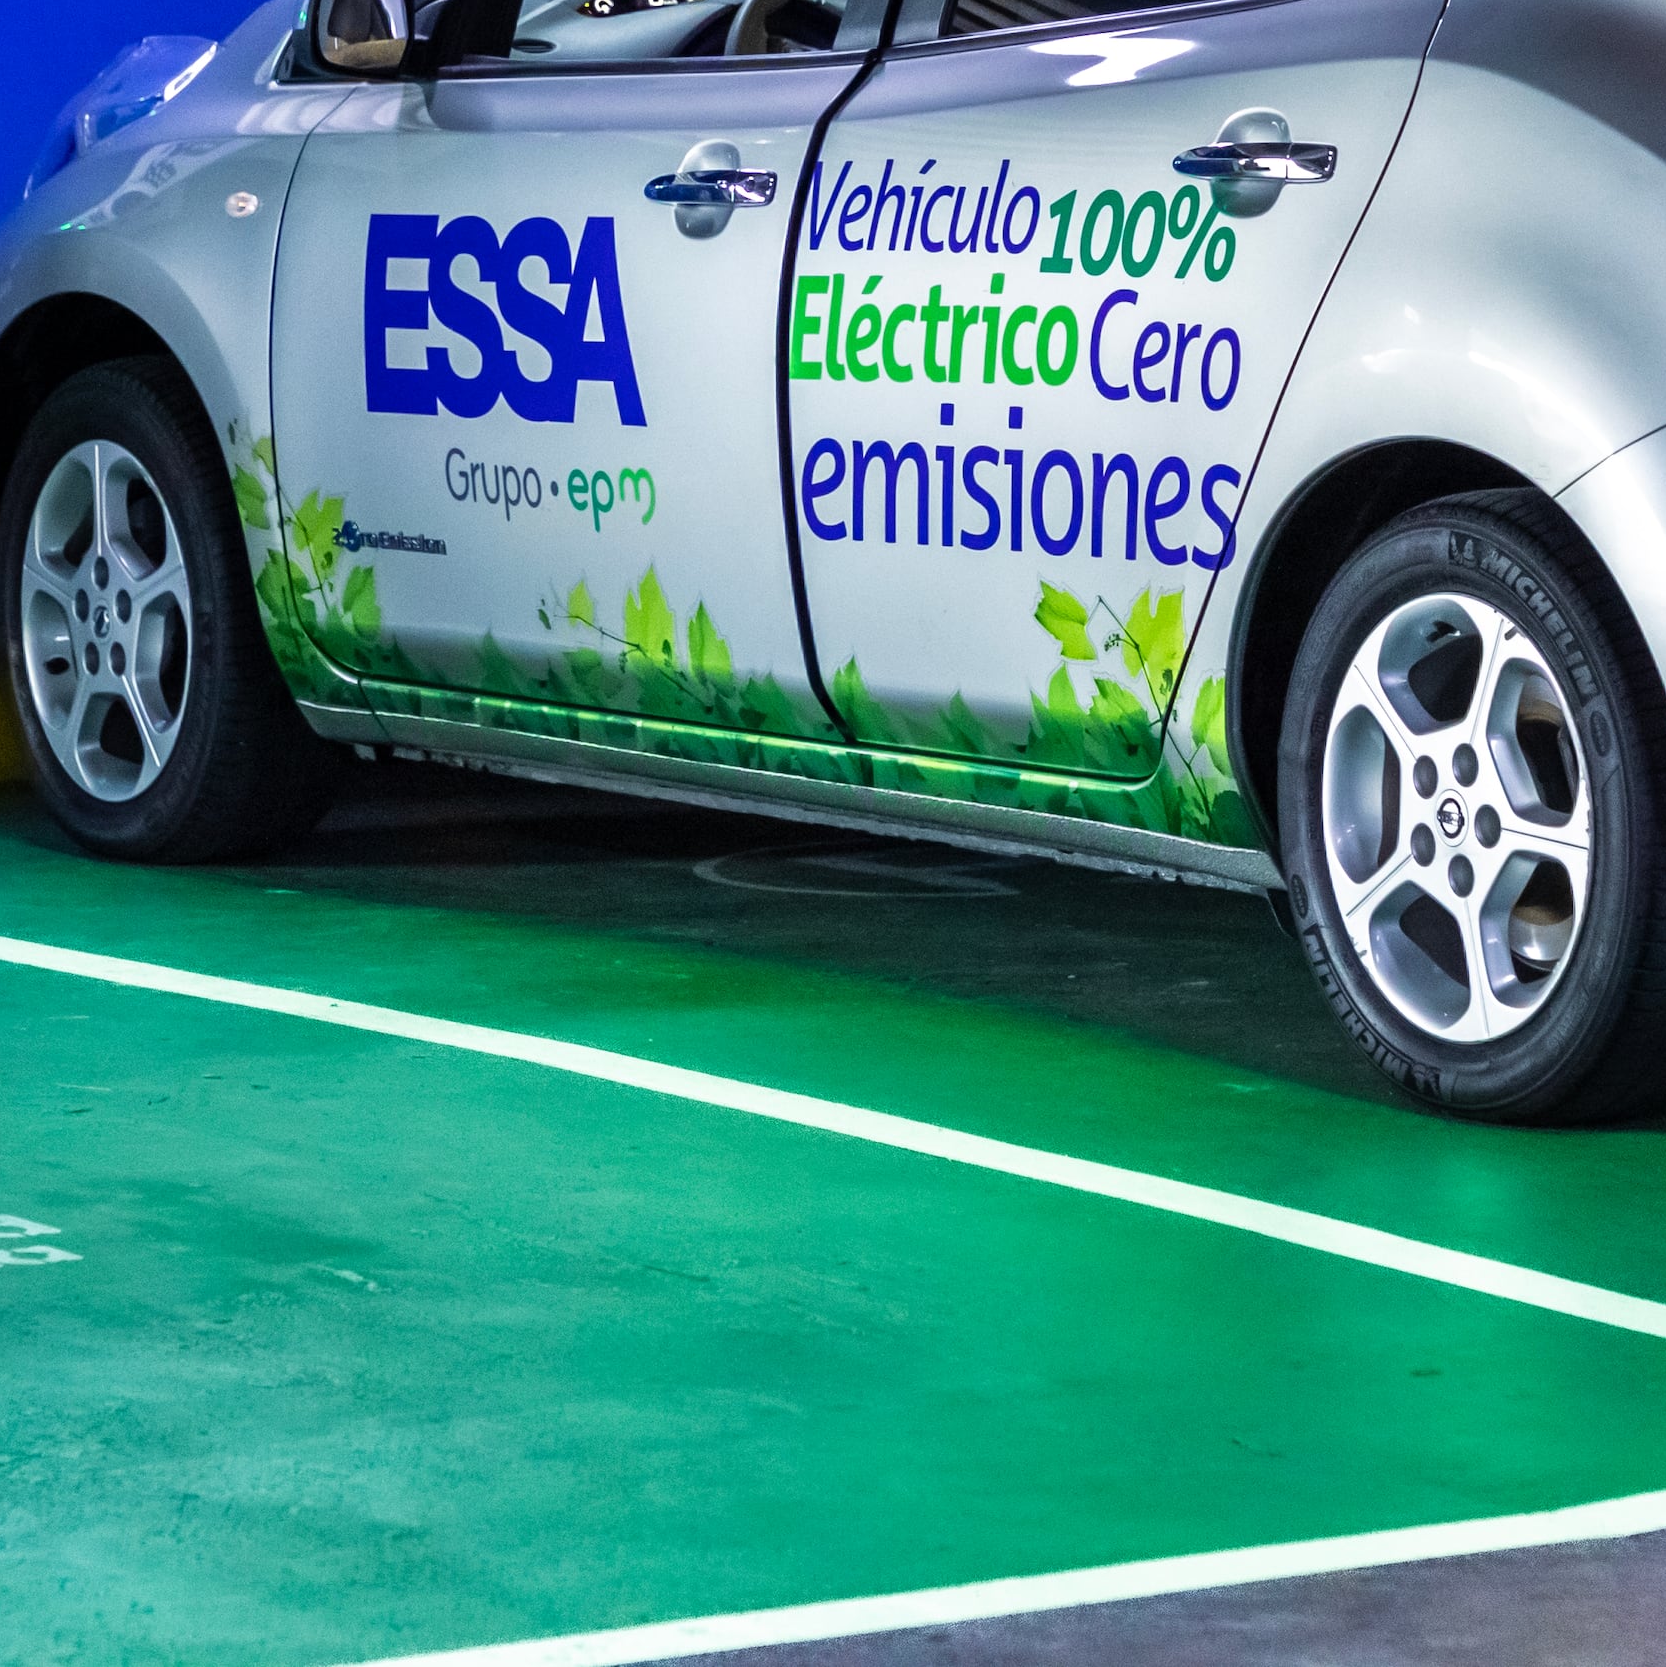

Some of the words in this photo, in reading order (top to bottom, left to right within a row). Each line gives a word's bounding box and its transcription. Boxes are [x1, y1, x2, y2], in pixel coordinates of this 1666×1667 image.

[807, 159, 1041, 254] Vehículo
[1039, 184, 1237, 283] 100%
[365, 213, 648, 427] ESSA
[789, 272, 1079, 387] Eléctrico
[1090, 288, 1242, 412] Cero
[801, 403, 1242, 572] emisiones
[1480, 550, 1599, 698] MICHELIN
